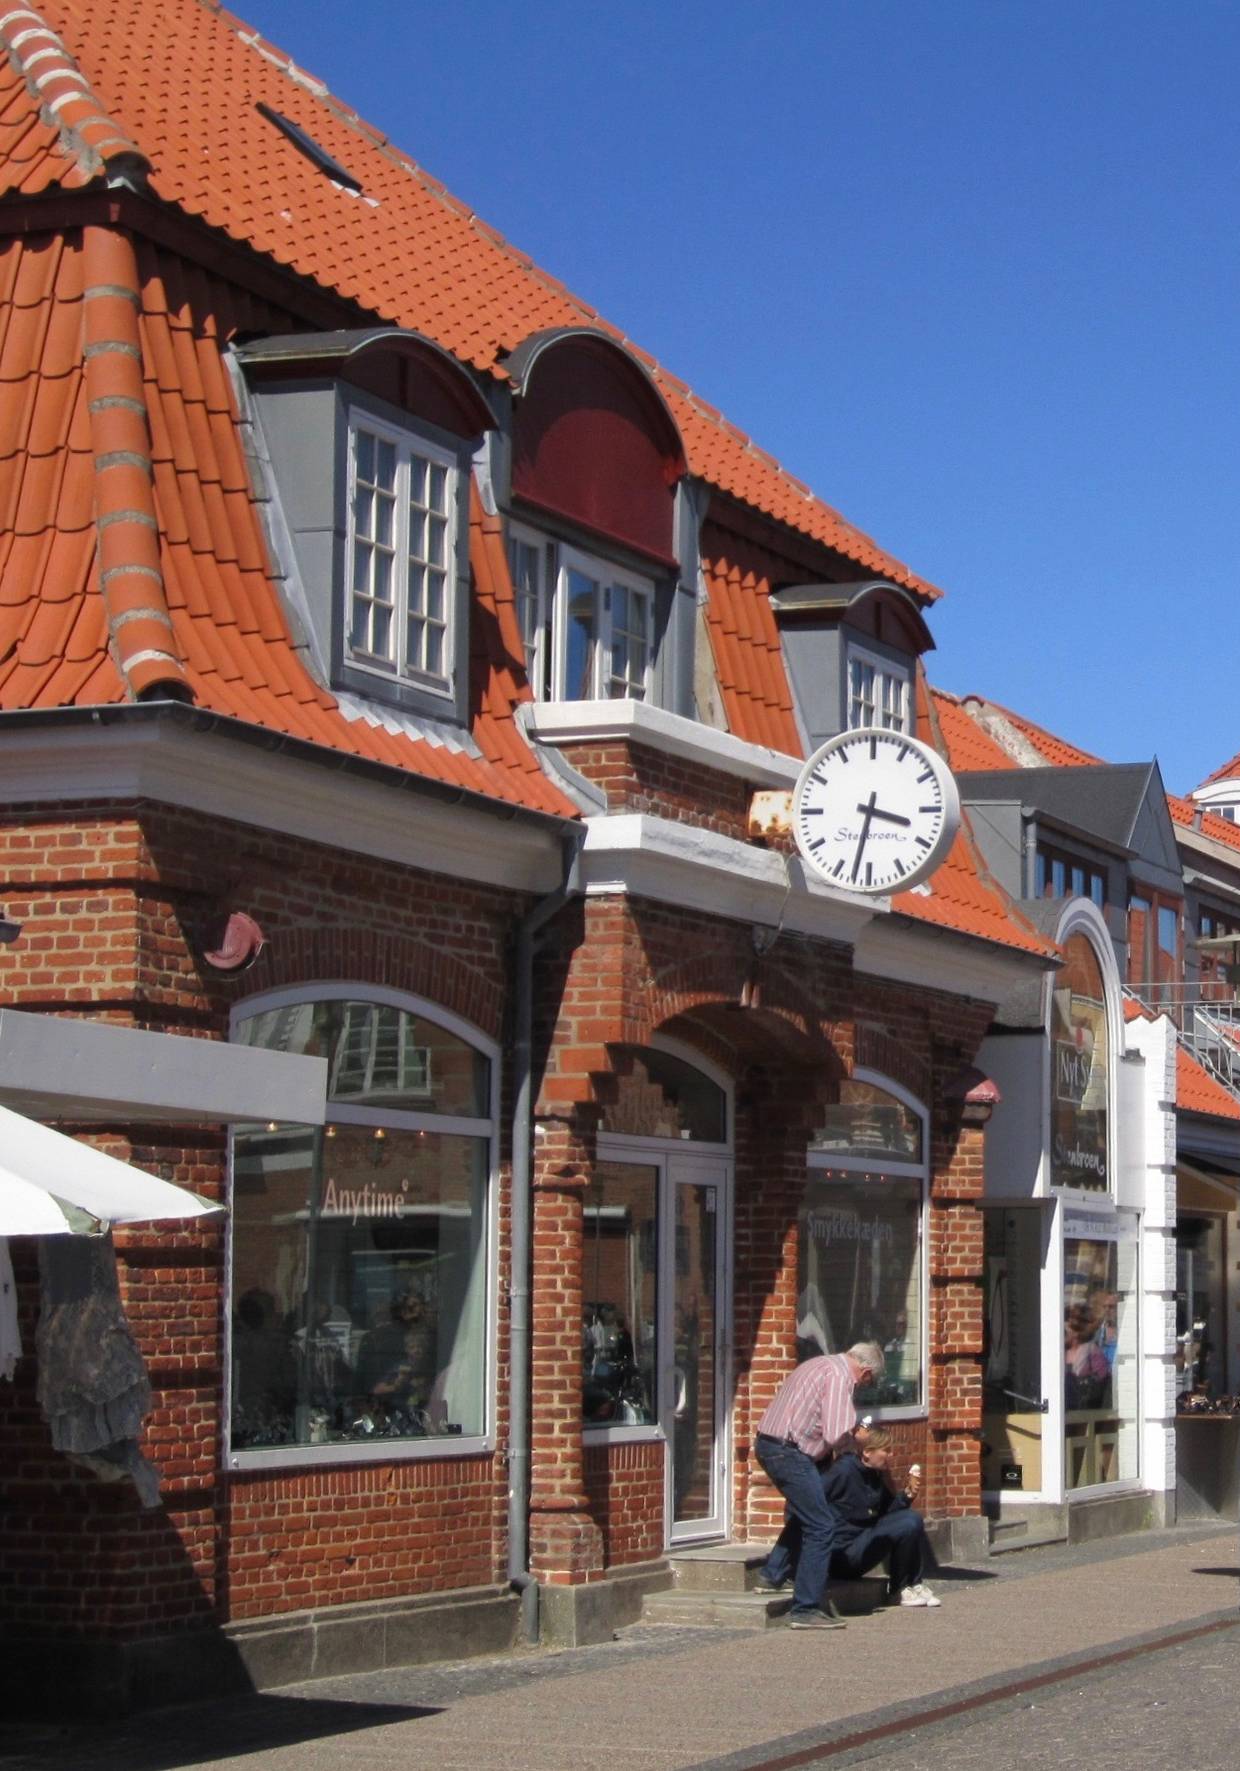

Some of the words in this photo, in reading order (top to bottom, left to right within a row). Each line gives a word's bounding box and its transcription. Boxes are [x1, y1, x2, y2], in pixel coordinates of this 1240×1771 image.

[833, 827, 907, 842] Stebroen
[1060, 1051, 1079, 1096] Nyt
[323, 1178, 406, 1226] Anytime
